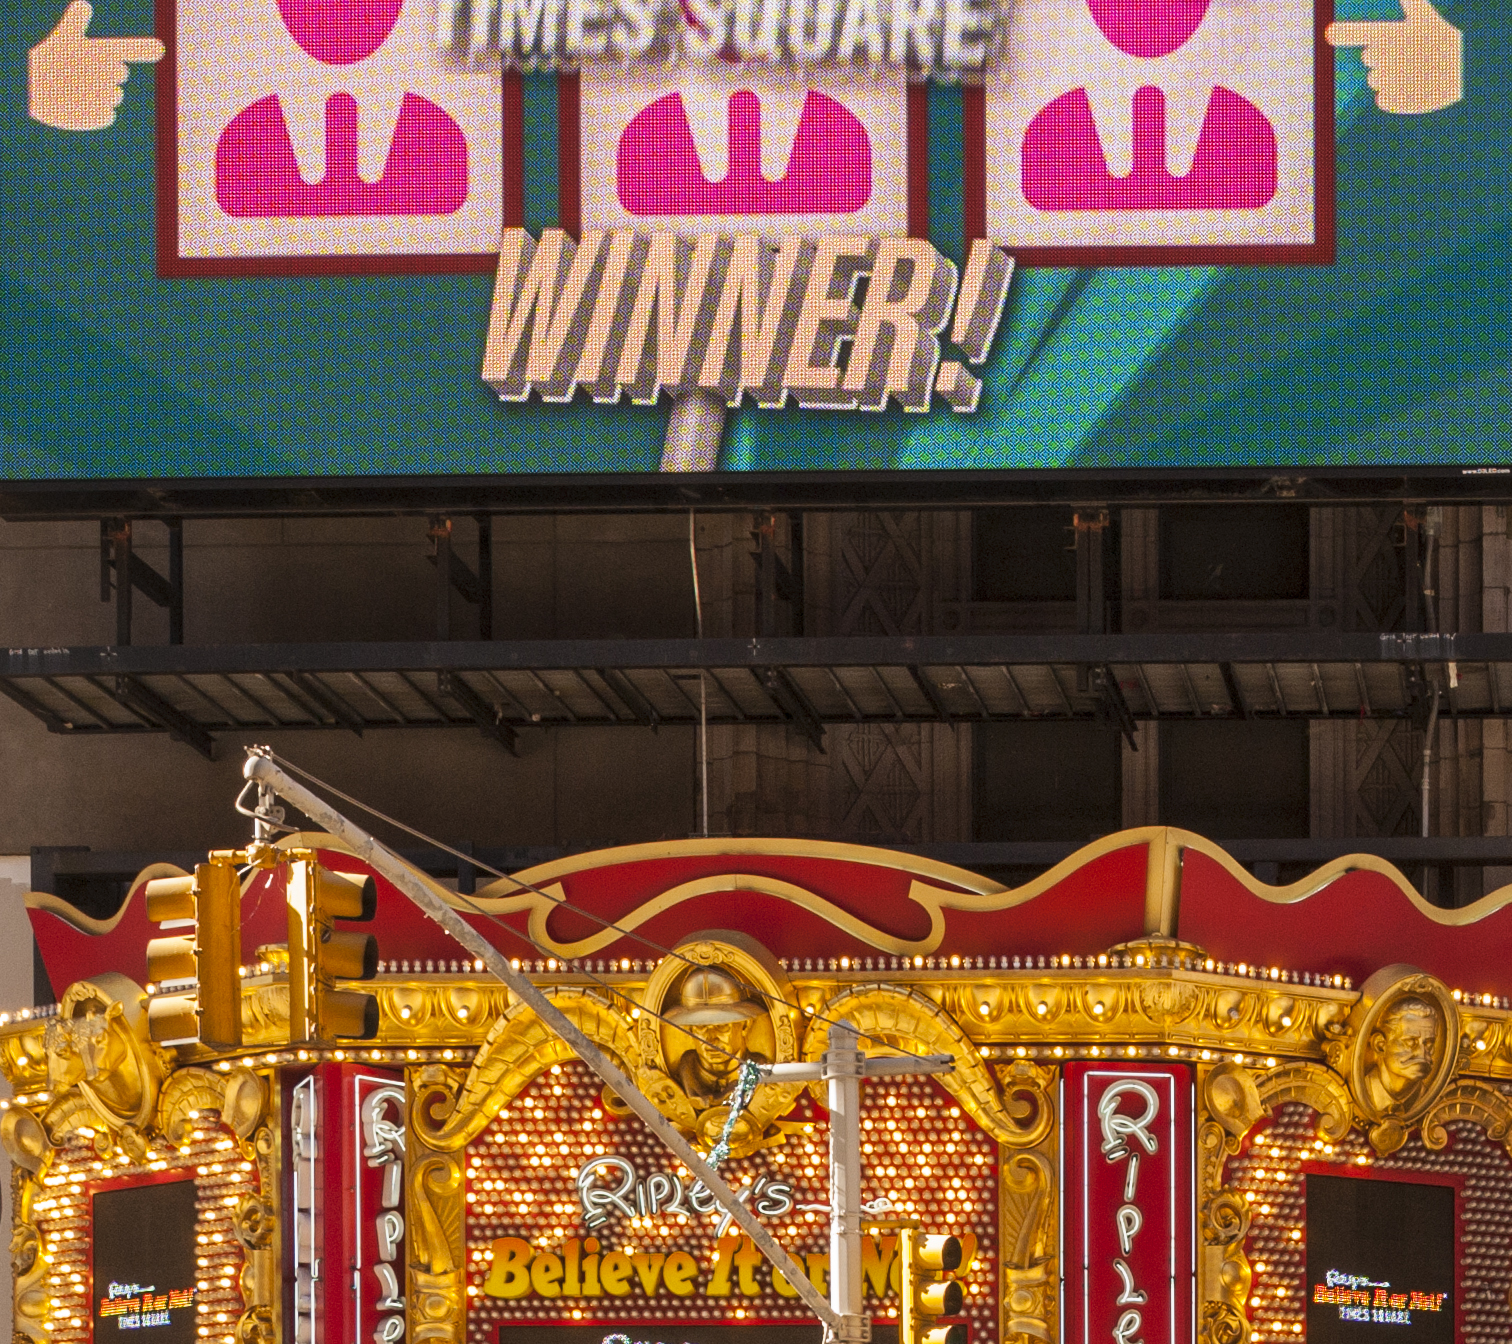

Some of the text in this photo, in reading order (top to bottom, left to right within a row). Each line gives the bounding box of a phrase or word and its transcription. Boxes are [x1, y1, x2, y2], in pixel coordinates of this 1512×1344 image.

[481, 226, 1015, 413] WINNER!
[484, 1235, 761, 1300] Believe It
